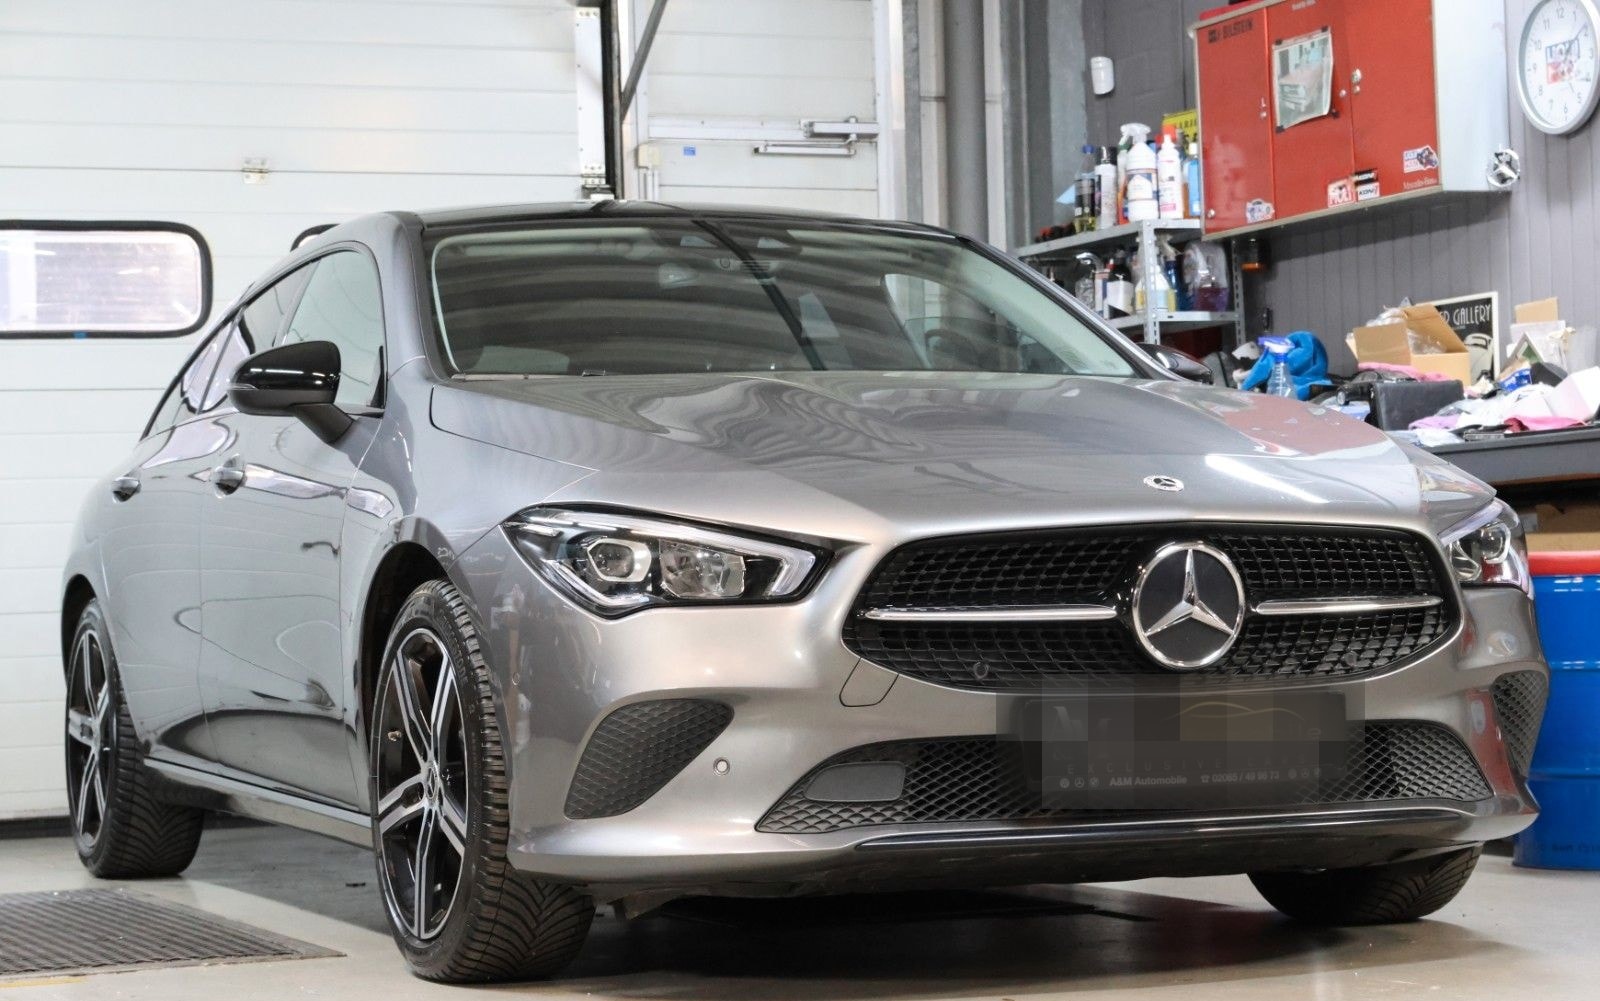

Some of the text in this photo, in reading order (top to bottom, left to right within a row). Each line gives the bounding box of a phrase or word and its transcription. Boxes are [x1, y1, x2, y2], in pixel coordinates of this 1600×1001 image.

[1453, 304, 1491, 325] GALLERY
[1109, 777, 1132, 786] A&M
[1134, 775, 1187, 785] Automobile
